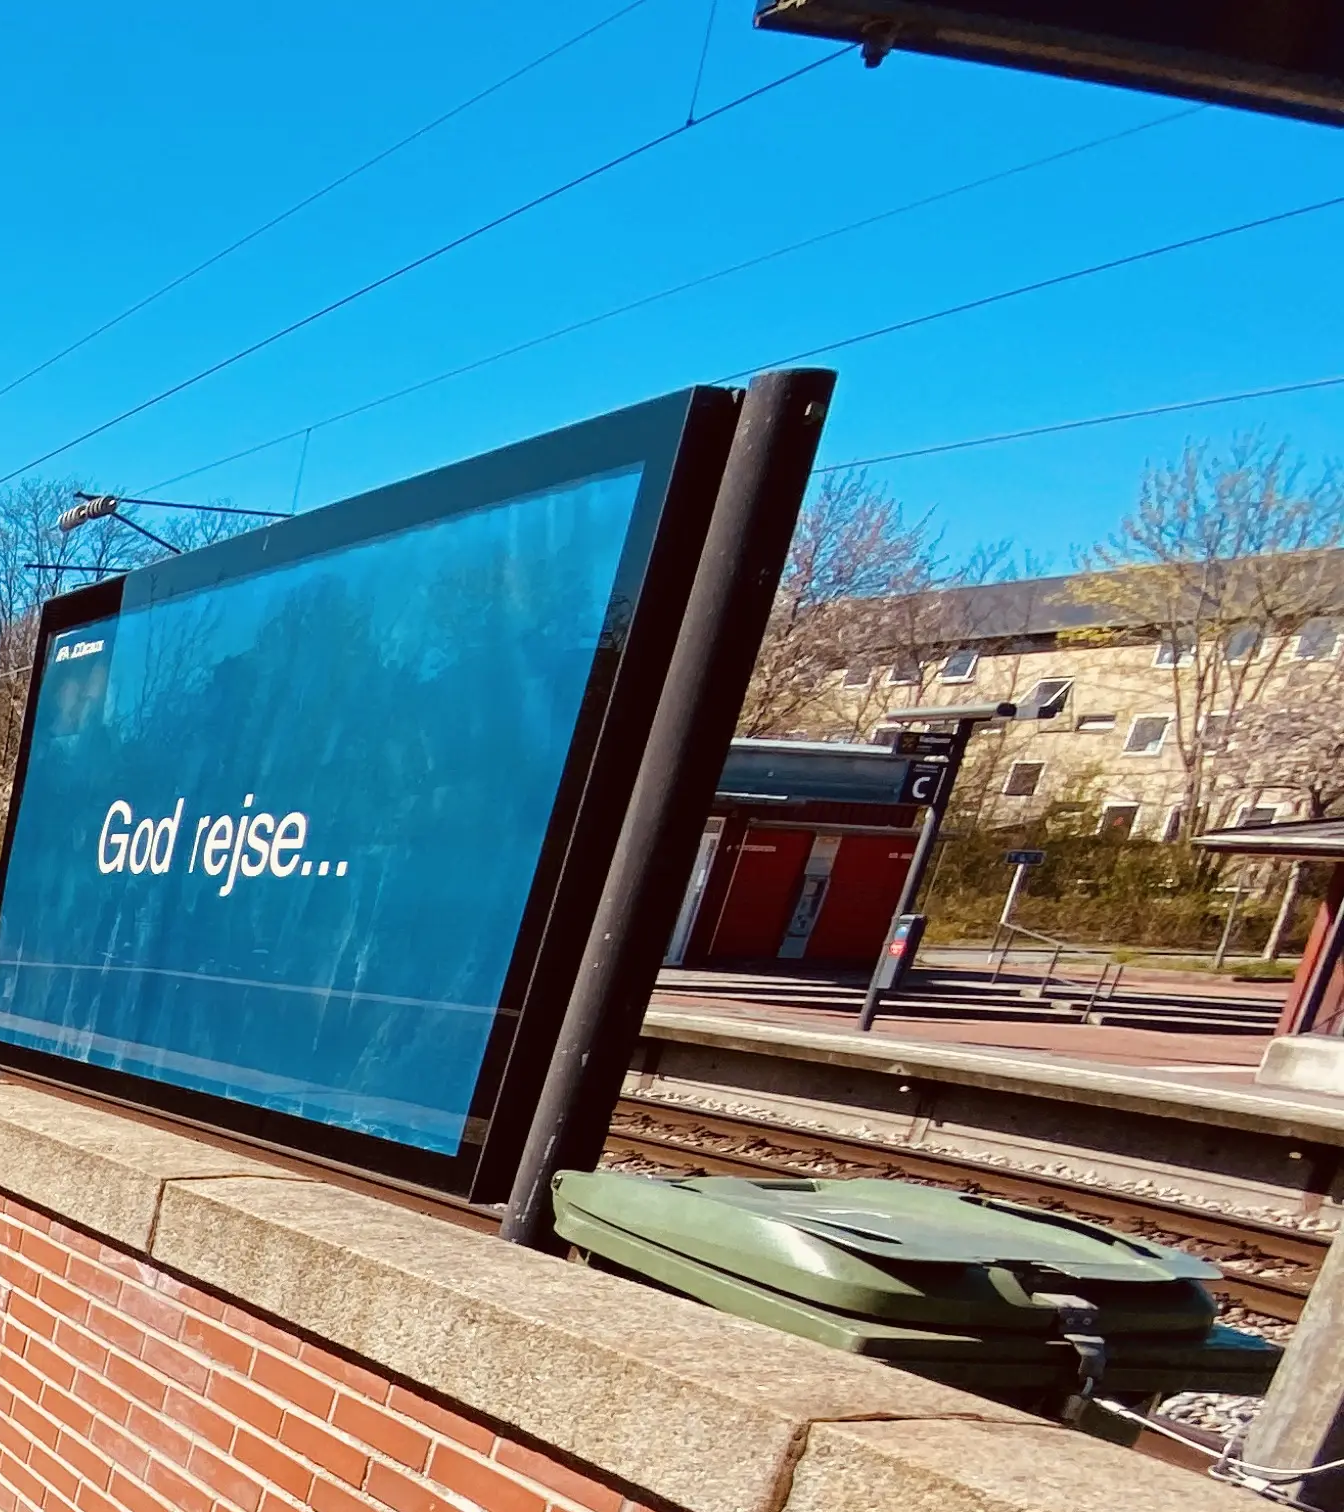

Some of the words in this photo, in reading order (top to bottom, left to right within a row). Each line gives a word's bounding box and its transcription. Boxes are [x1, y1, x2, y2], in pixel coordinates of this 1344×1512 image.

[912, 776, 931, 799] C
[98, 797, 185, 875] God
[188, 793, 348, 897] rejse...
